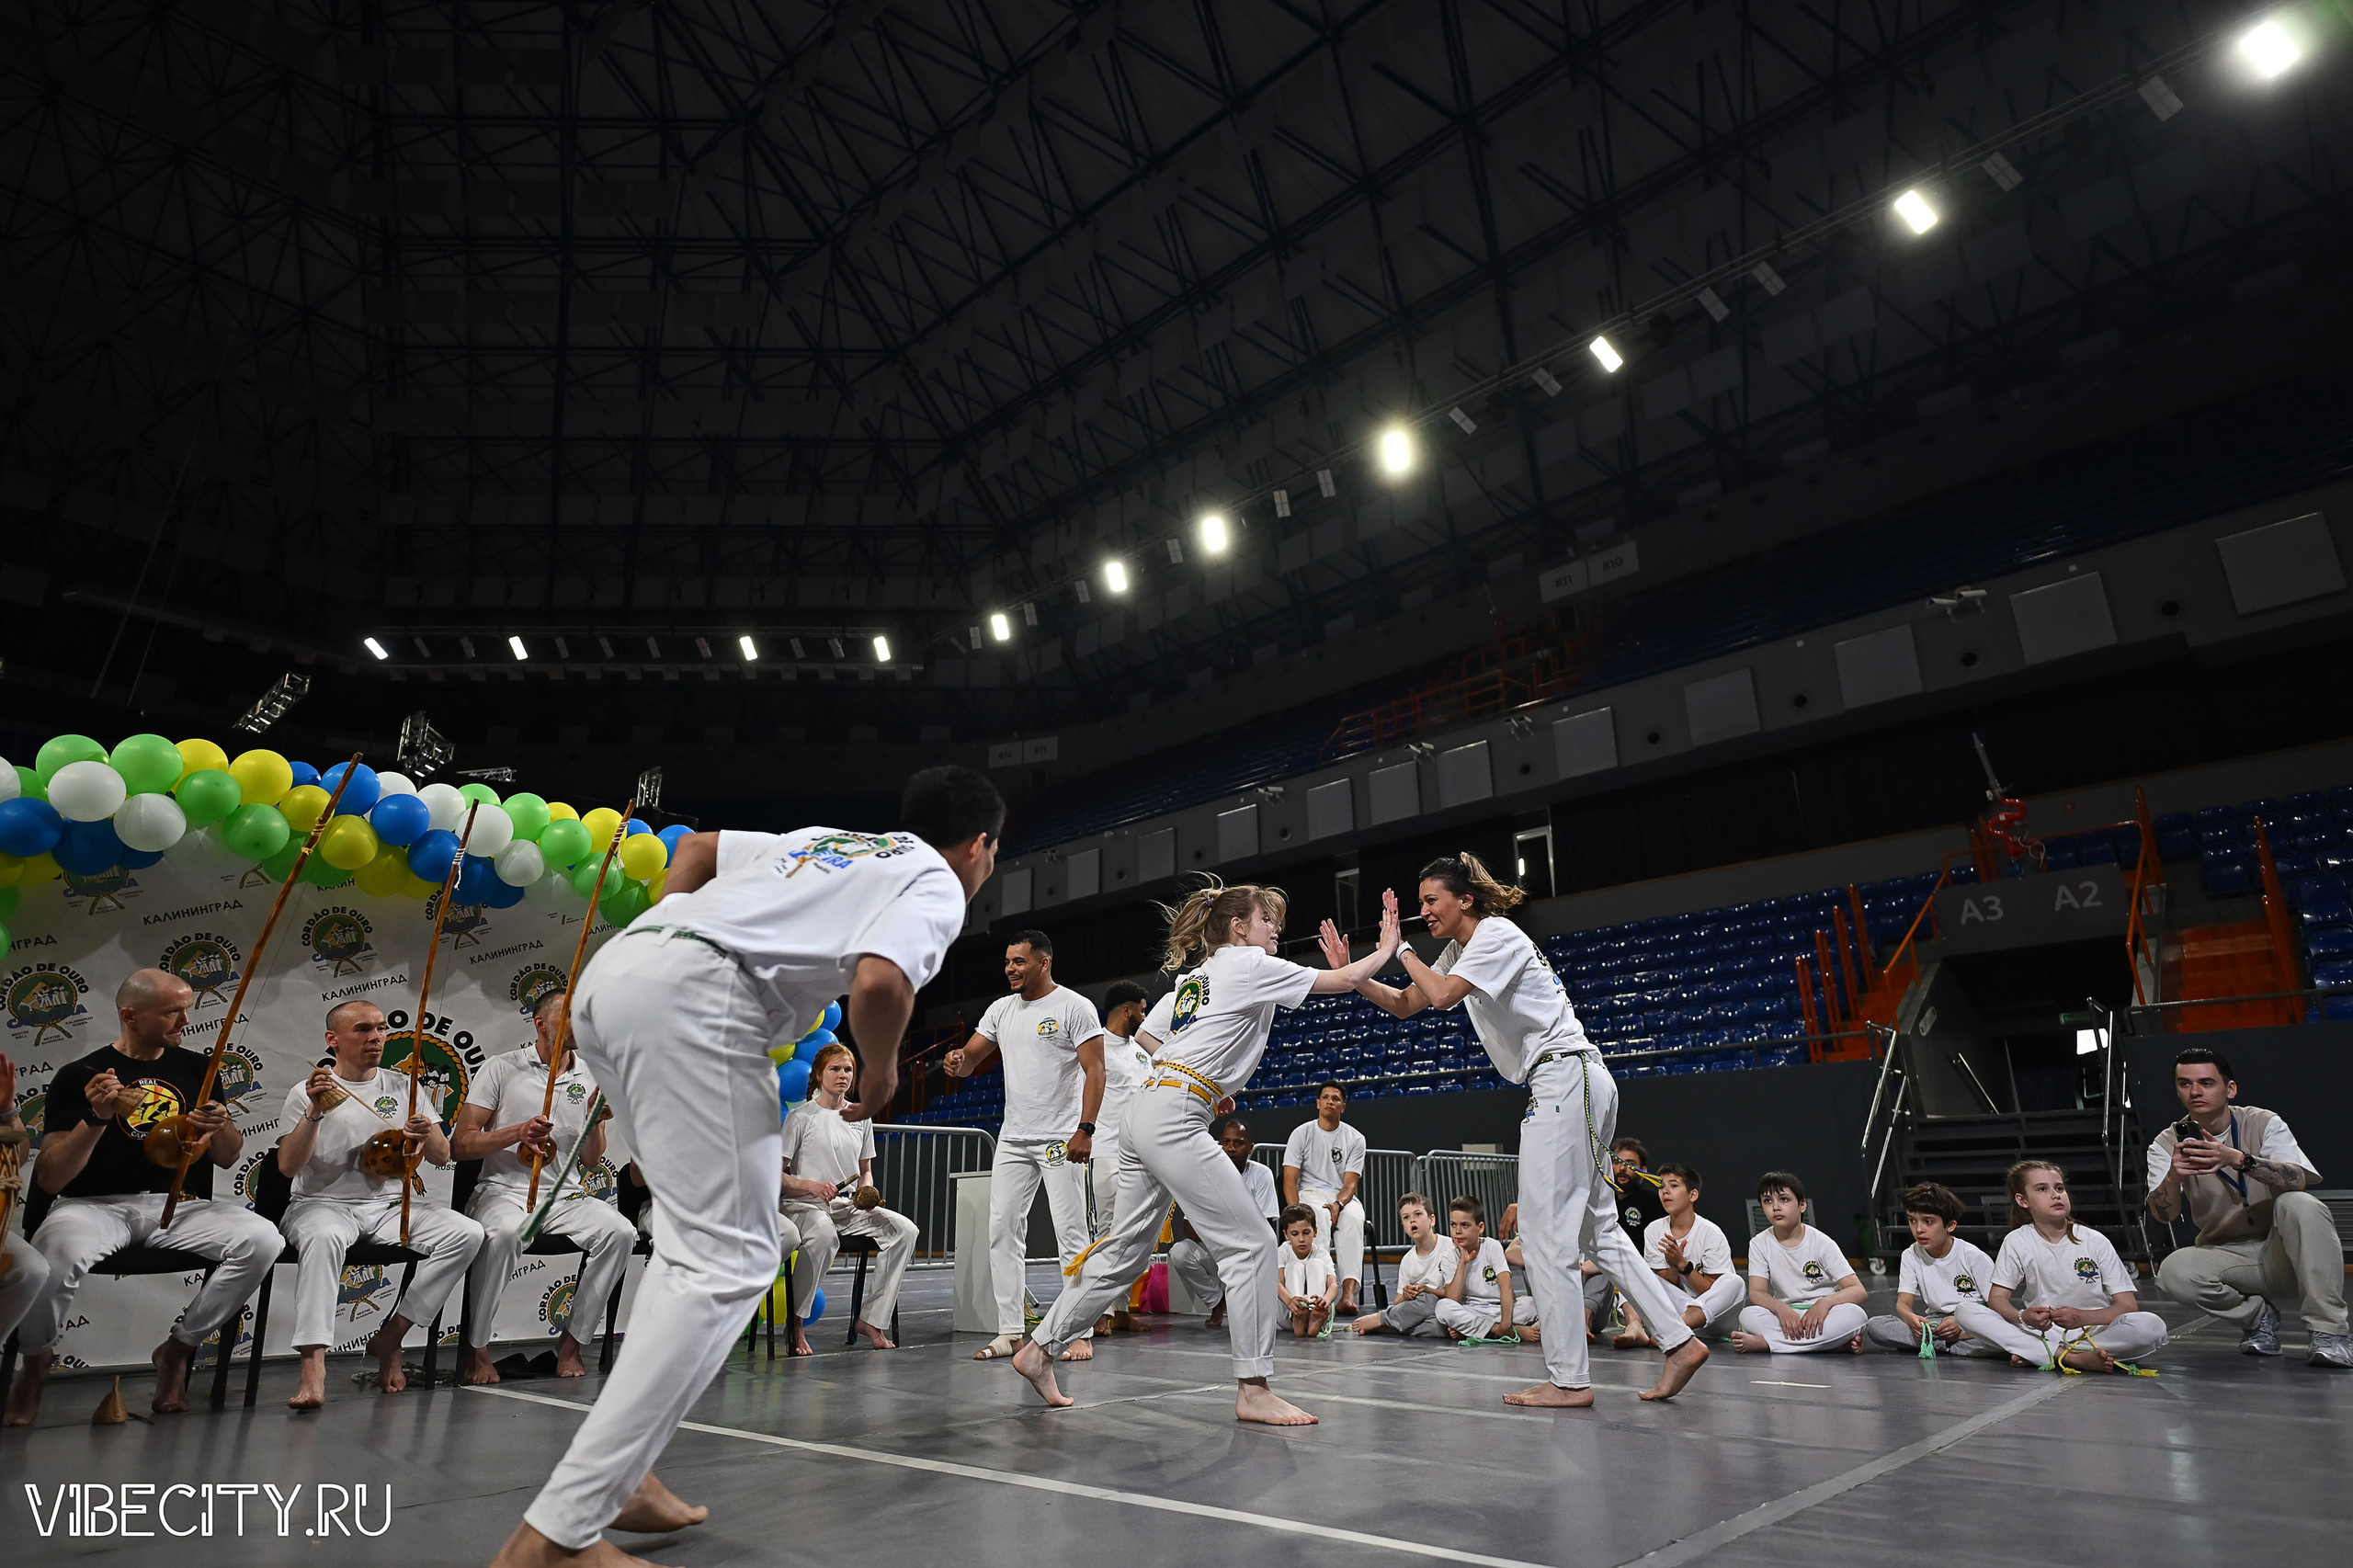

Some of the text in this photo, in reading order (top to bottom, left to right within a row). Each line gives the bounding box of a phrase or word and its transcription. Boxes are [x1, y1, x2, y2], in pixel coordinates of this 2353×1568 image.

[1602, 556, 1623, 571] B10
[1555, 574, 1572, 588] B11
[1961, 895, 2004, 925] A3
[2054, 881, 2103, 912] A2
[142, 899, 243, 926] КАЛИНИНГРАД
[301, 908, 330, 947] CORDÃO
[349, 909, 373, 934] OURO
[159, 933, 241, 973] ORDÃO DE OURO
[470, 939, 544, 964] КАЛИНИНГРАД
[37, 963, 56, 971] DE
[59, 965, 89, 994] OURO
[322, 974, 407, 1002] КАЛИНИНГРАД
[510, 965, 532, 1001] CORDÃO
[549, 965, 568, 987] OURO
[236, 1046, 263, 1071] OURO
[233, 1151, 266, 1196] CORDÃO
[600, 1157, 619, 1178] OURO
[539, 1274, 576, 1322] CORDÃO DE
